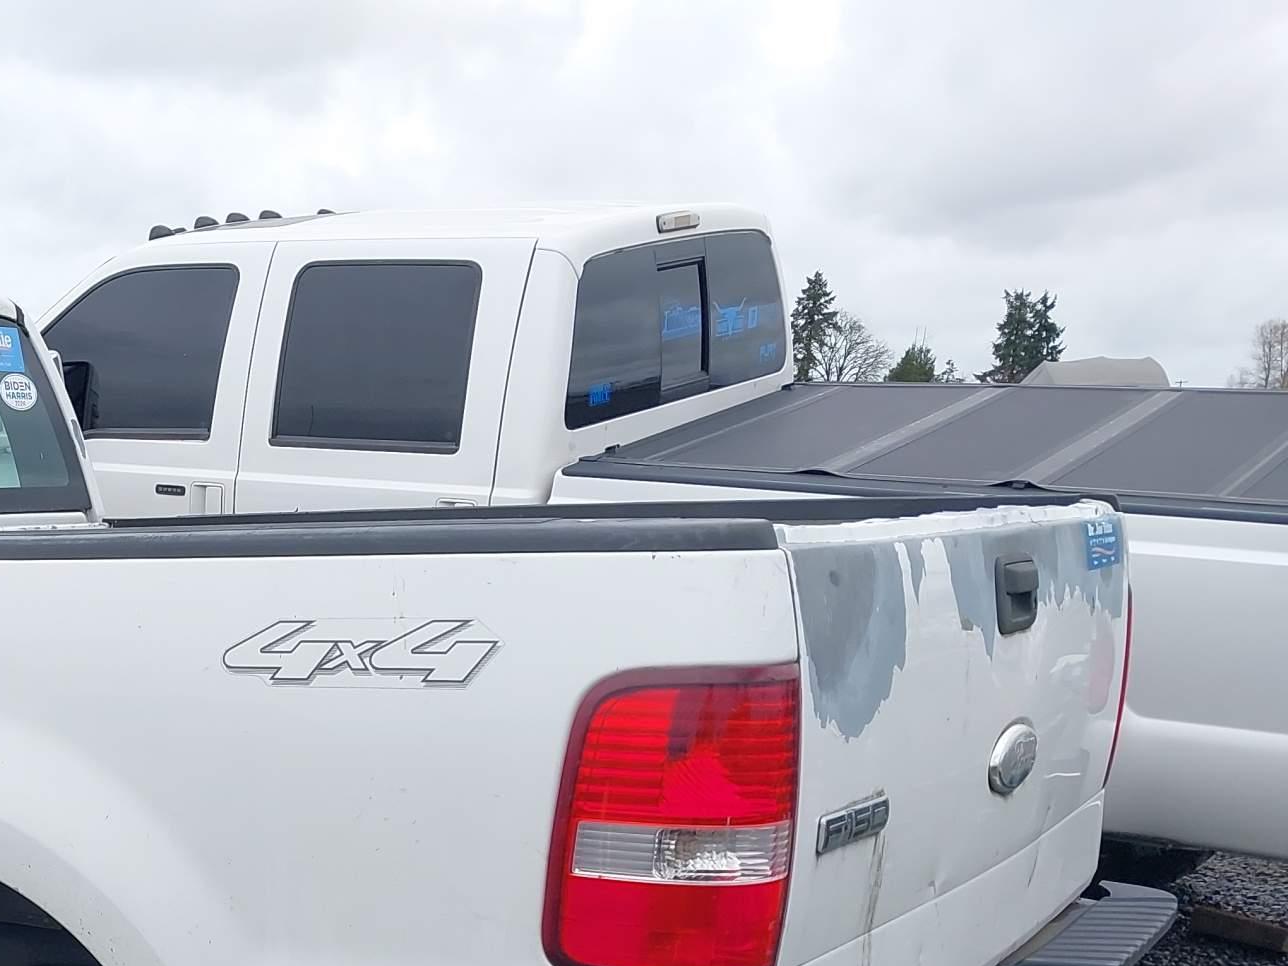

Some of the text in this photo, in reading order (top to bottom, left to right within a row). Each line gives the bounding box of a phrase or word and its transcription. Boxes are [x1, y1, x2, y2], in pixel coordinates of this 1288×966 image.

[4, 380, 31, 391] BIDEN
[5, 391, 33, 400] HARRIS
[222, 618, 501, 689] 4x4
